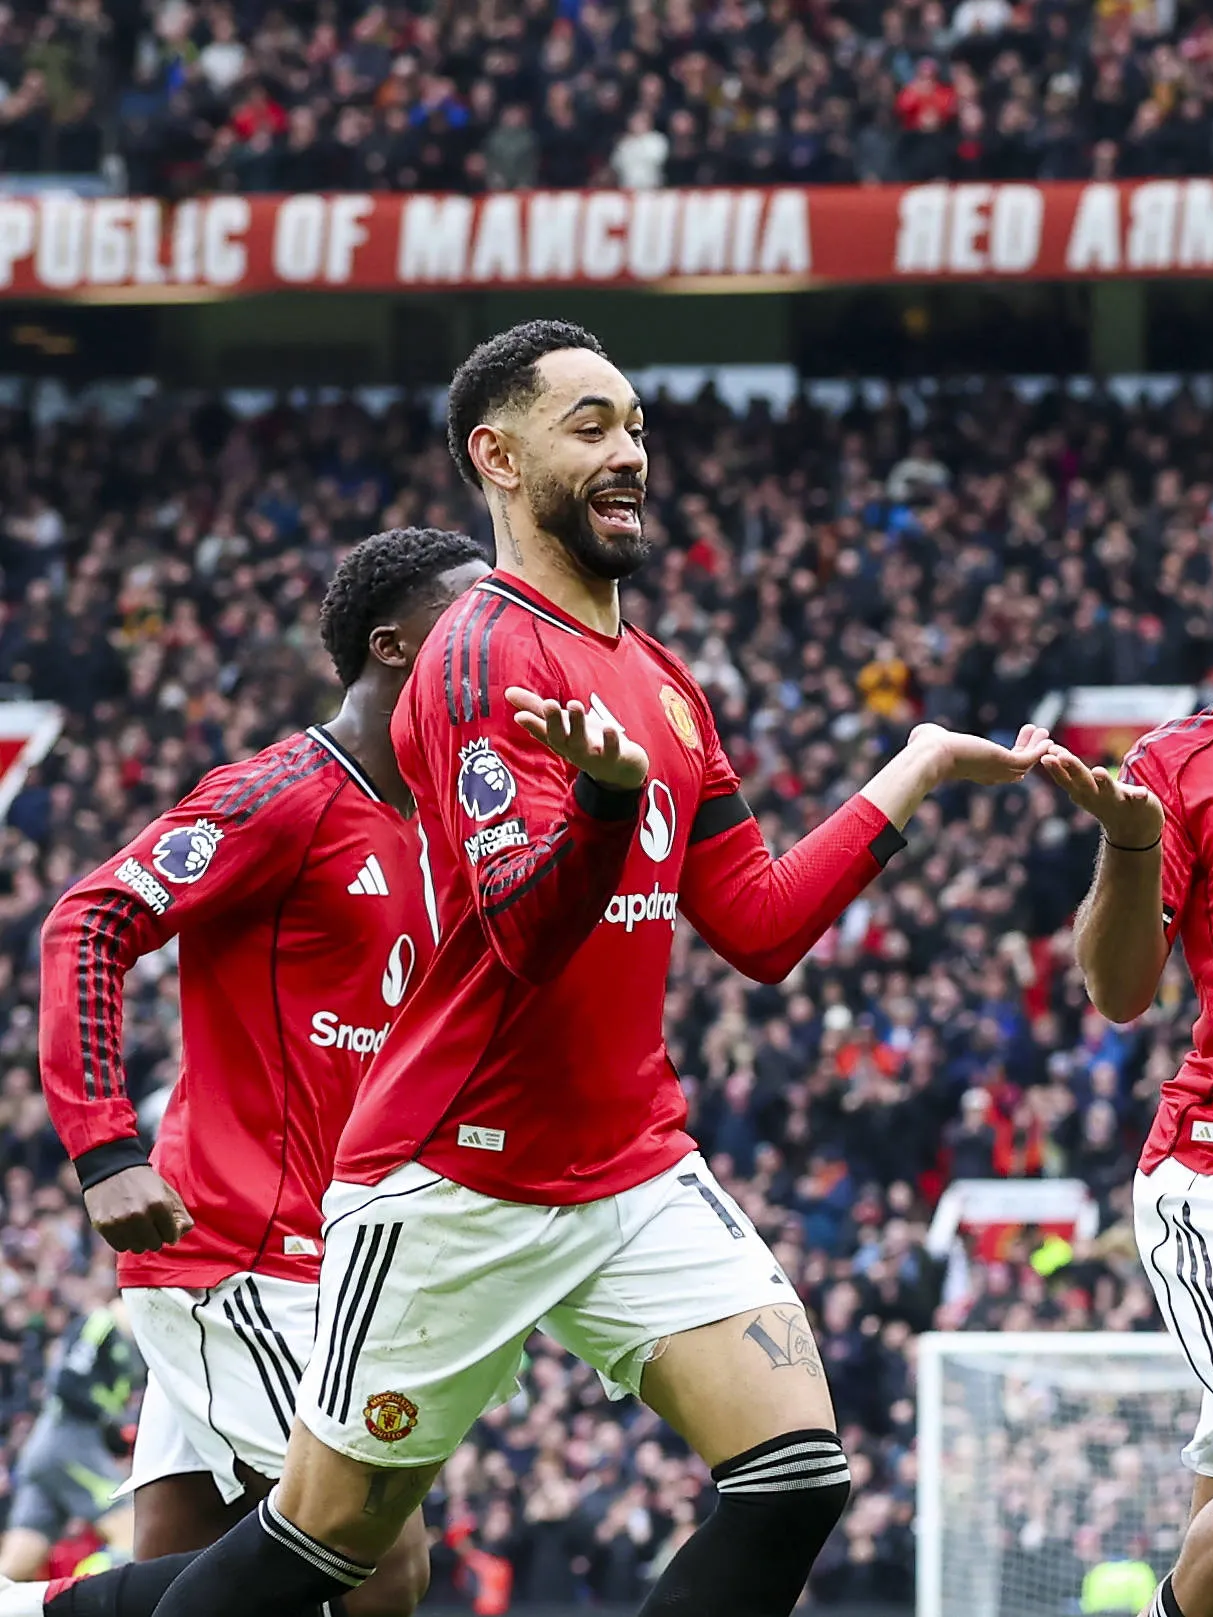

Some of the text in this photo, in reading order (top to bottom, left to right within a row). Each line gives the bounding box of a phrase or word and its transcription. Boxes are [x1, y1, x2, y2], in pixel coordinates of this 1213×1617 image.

[272, 193, 375, 284] OF
[479, 820, 519, 844] room
[137, 871, 170, 904] room
